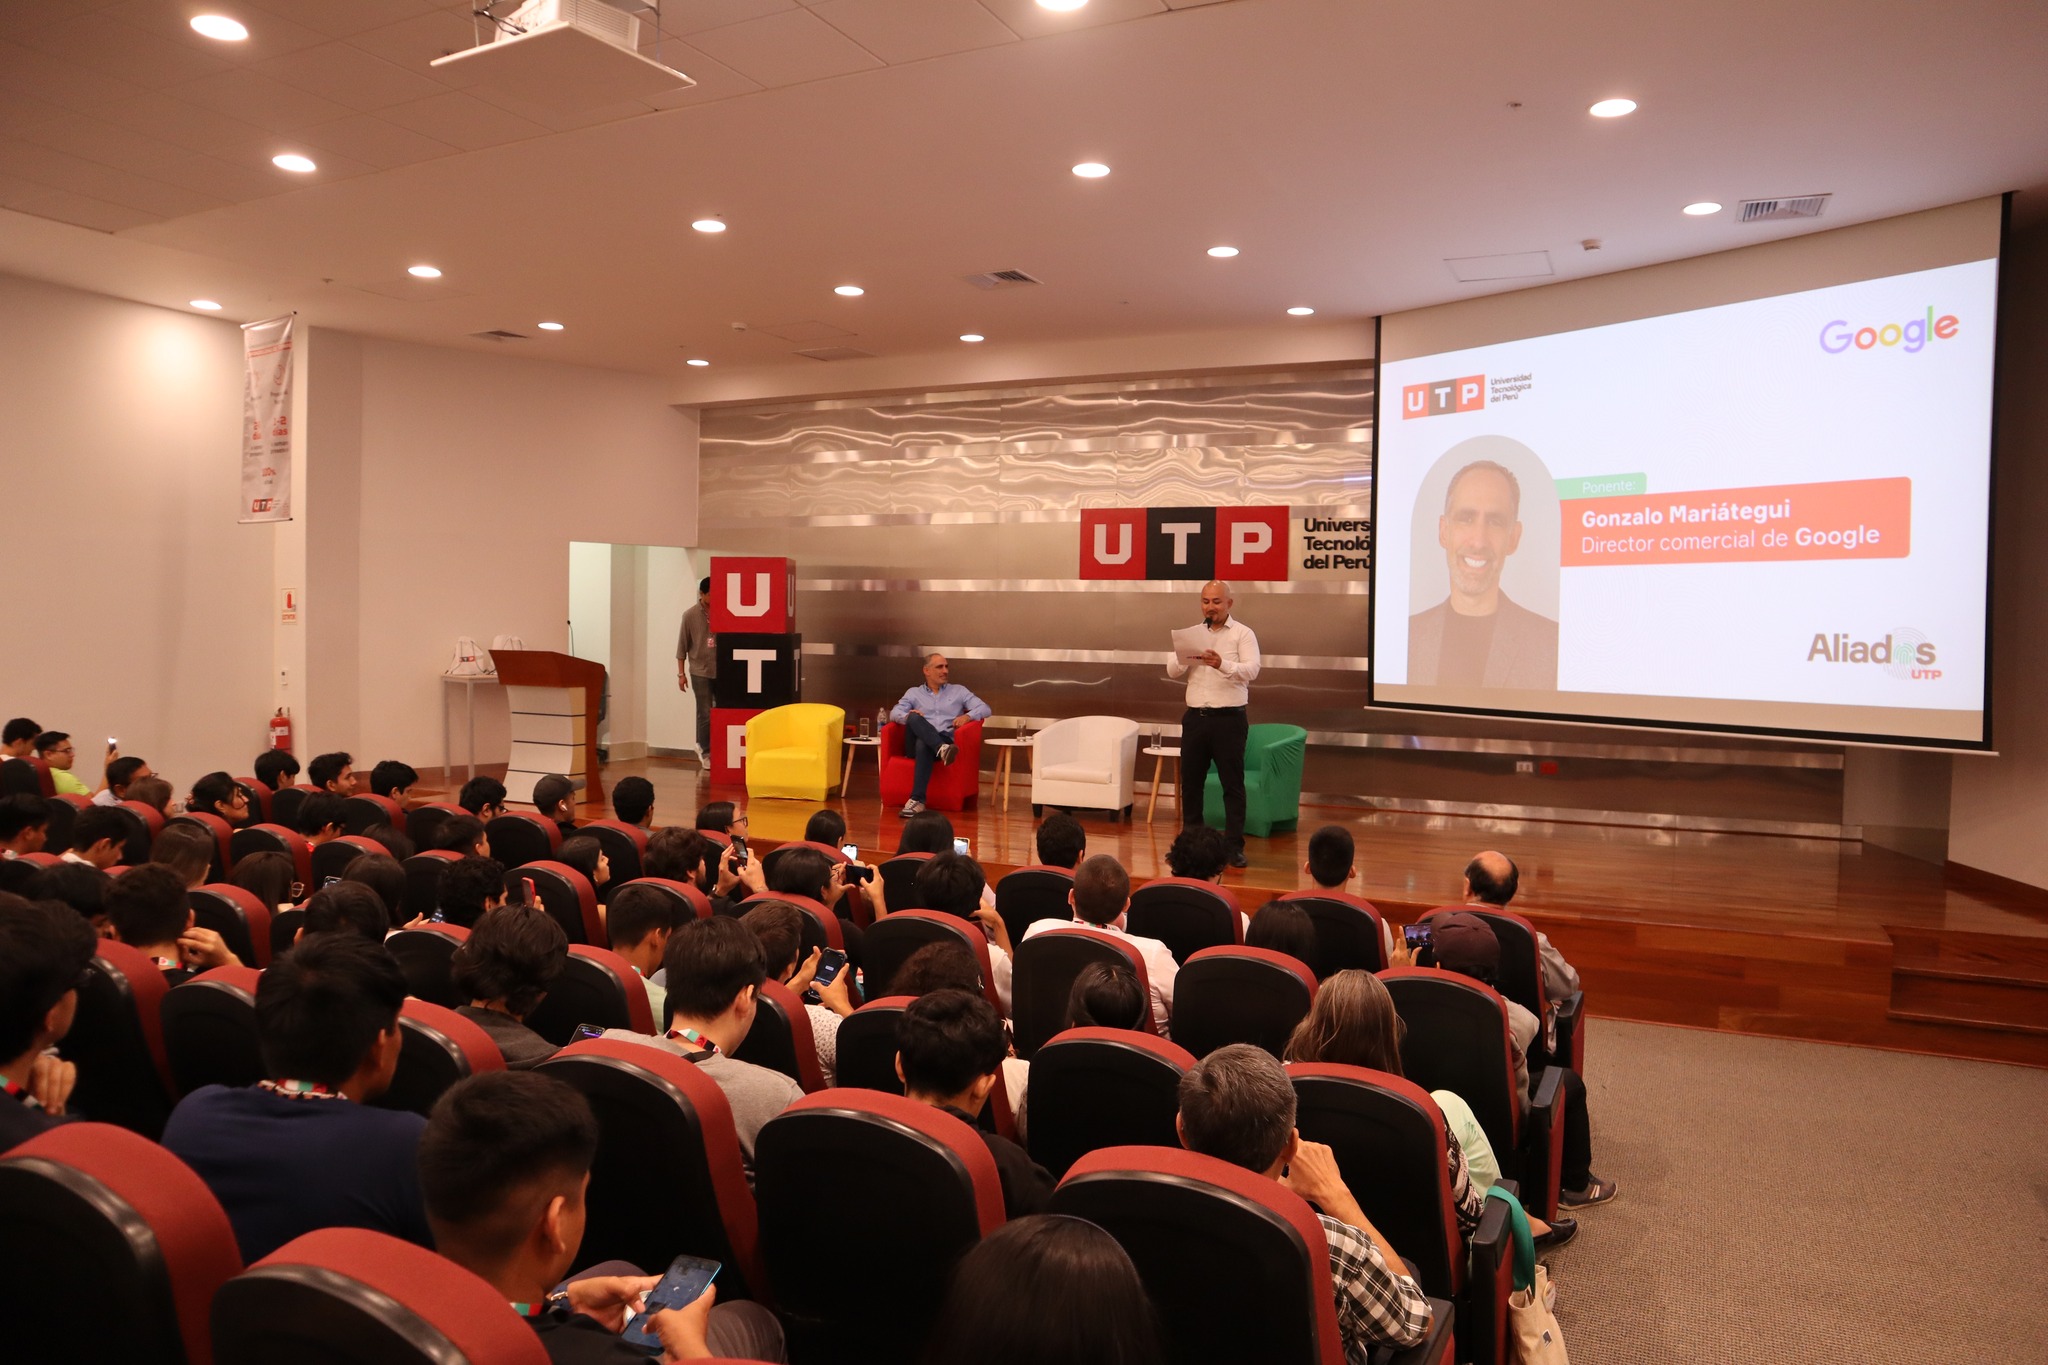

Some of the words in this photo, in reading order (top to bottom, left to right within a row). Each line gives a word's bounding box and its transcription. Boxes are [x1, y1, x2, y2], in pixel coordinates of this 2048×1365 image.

[1819, 305, 1960, 354] Google
[1490, 373, 1533, 386] Universidad
[1490, 383, 1532, 395] Tecnológica
[1490, 394, 1502, 403] del
[1502, 391, 1519, 402] Perú
[1407, 383, 1480, 412] UTP
[1582, 480, 1637, 494] Ponente:
[1582, 507, 1664, 529] Gonzalo
[1669, 499, 1791, 525] Mariátegui
[1093, 521, 1273, 565] UTP
[1582, 535, 1656, 555] Director
[1659, 530, 1755, 551] comercial
[1762, 528, 1789, 548] de
[1794, 525, 1880, 550] Google
[1303, 554, 1330, 569] del
[1332, 553, 1371, 569] Perú
[1911, 669, 1943, 680] UTP
